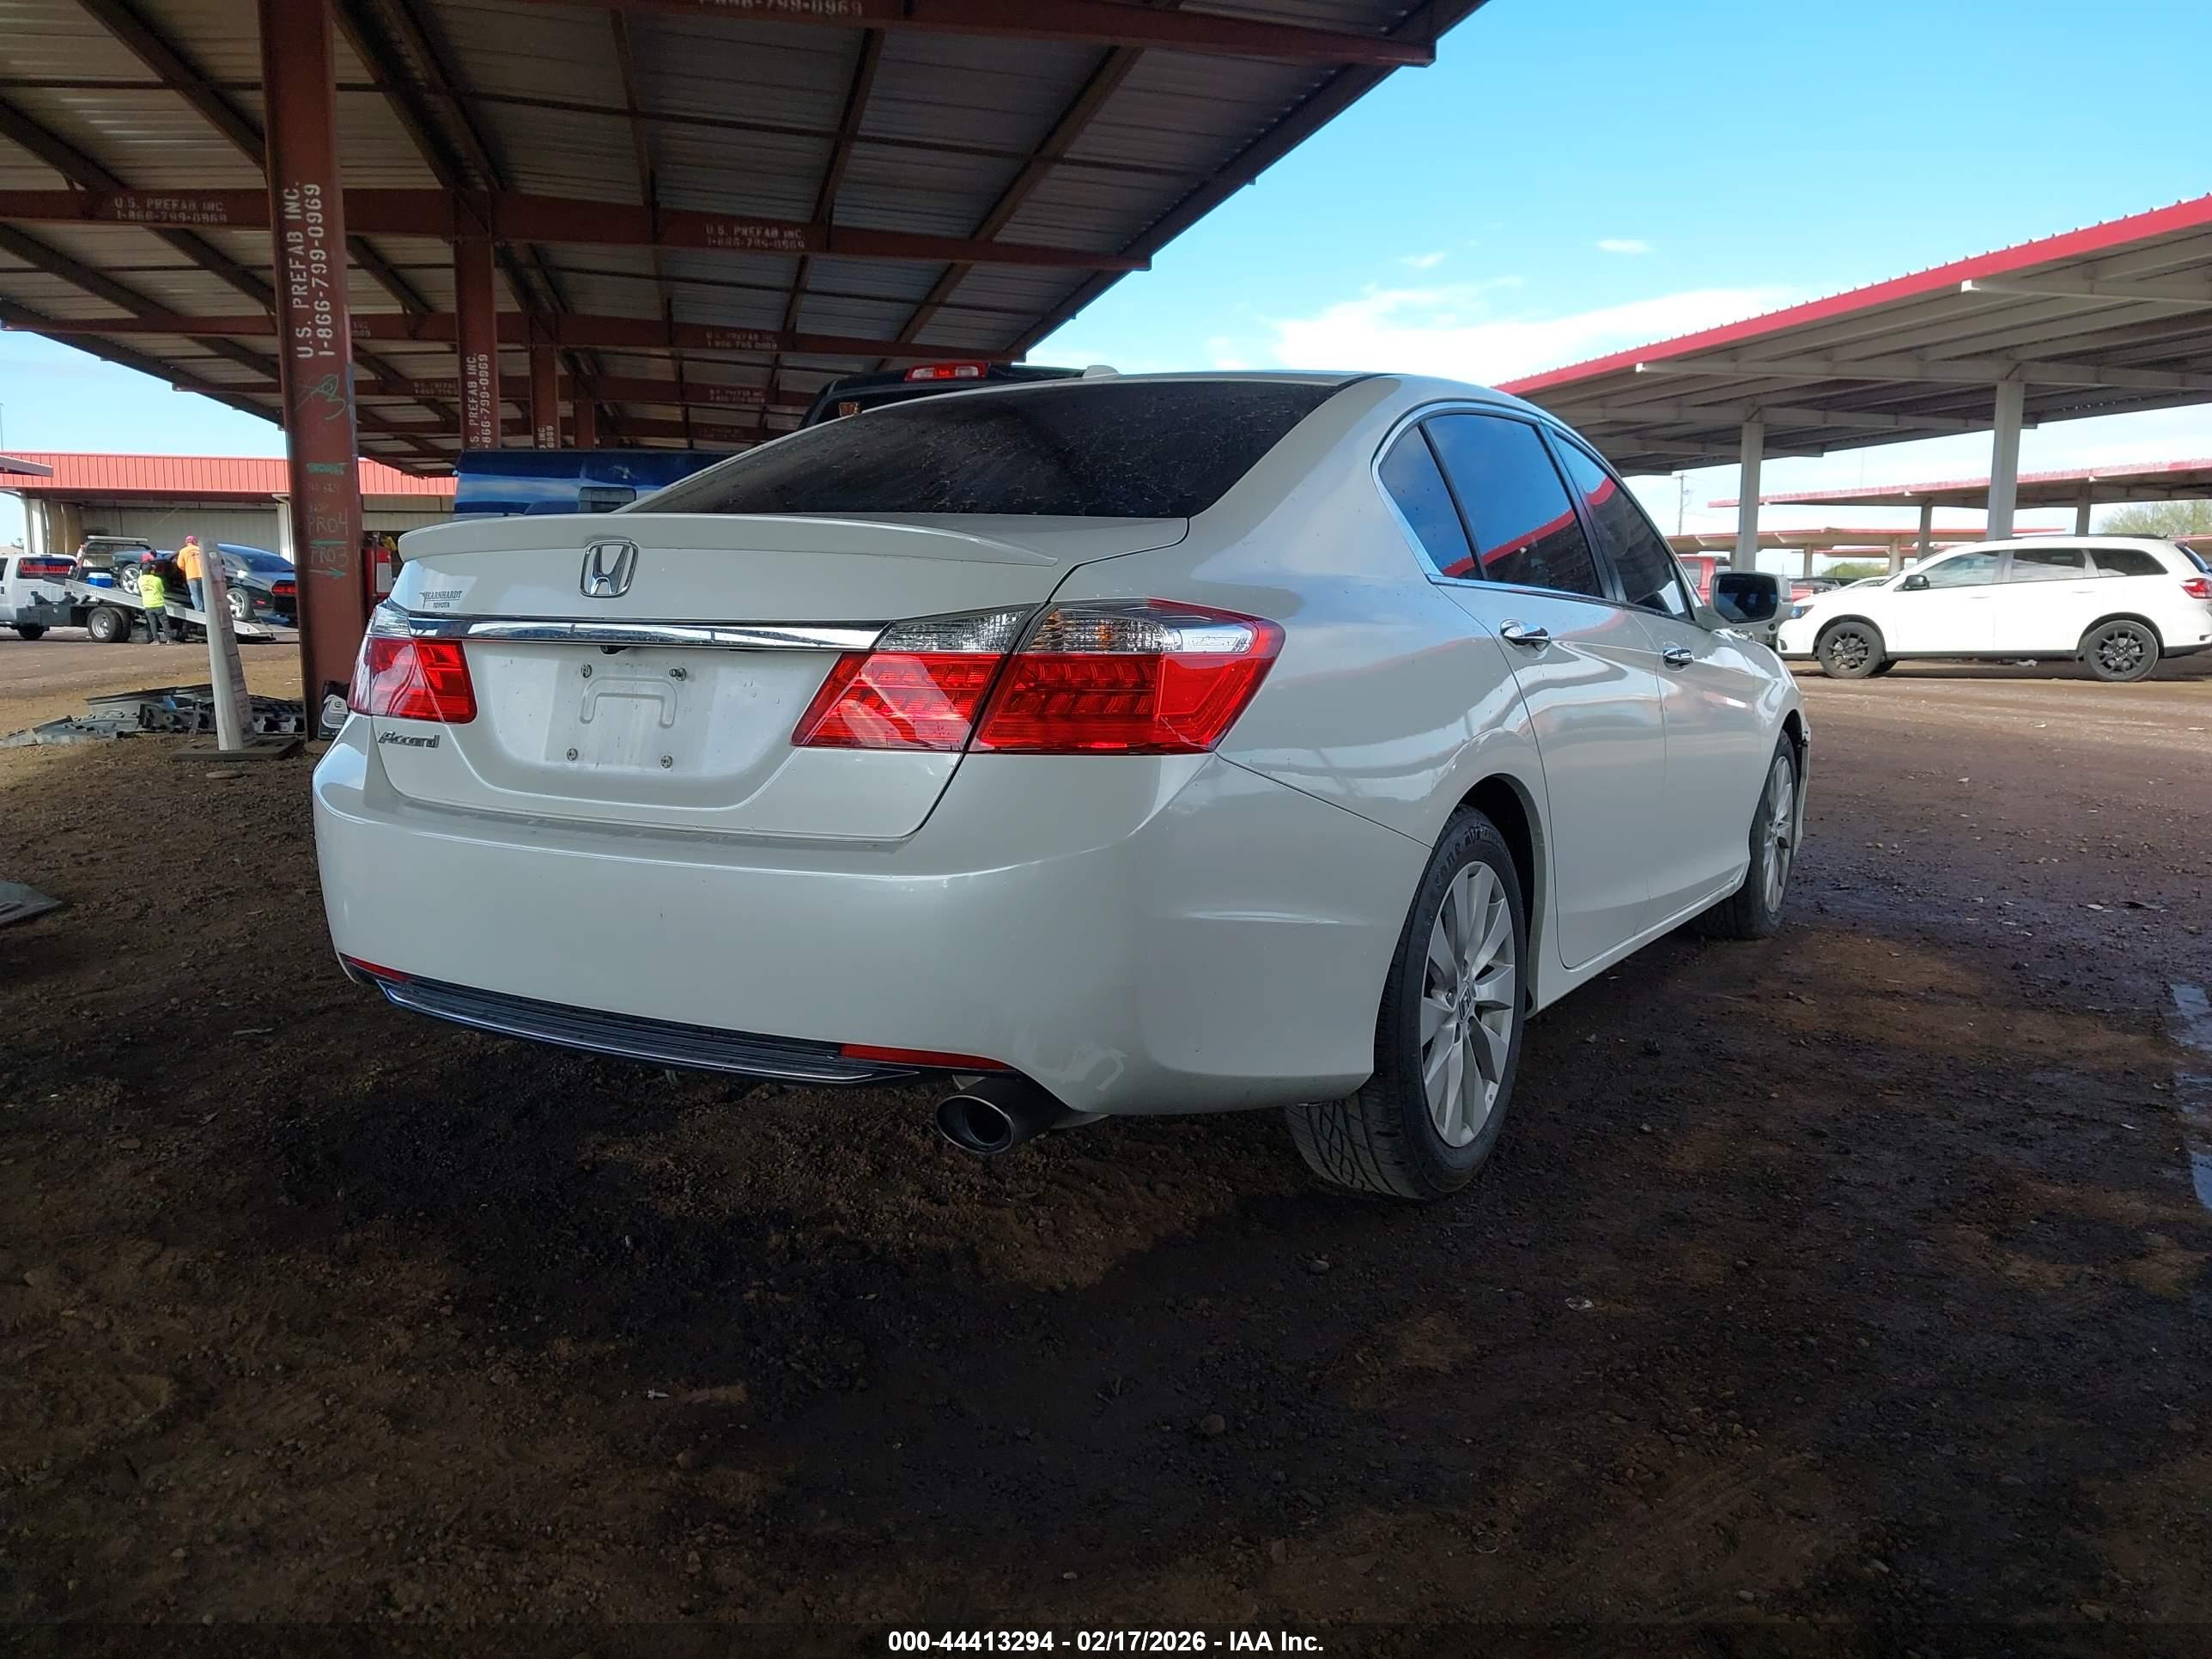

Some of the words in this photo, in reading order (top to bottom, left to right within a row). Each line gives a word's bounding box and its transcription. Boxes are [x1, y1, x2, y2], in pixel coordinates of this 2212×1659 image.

[283, 181, 302, 220] INC.
[287, 231, 310, 309] PREFAB
[303, 184, 336, 356] 1-866-799-0969
[295, 320, 314, 358] U.S.
[466, 380, 479, 427] PREFAB
[378, 730, 441, 749] Accord
